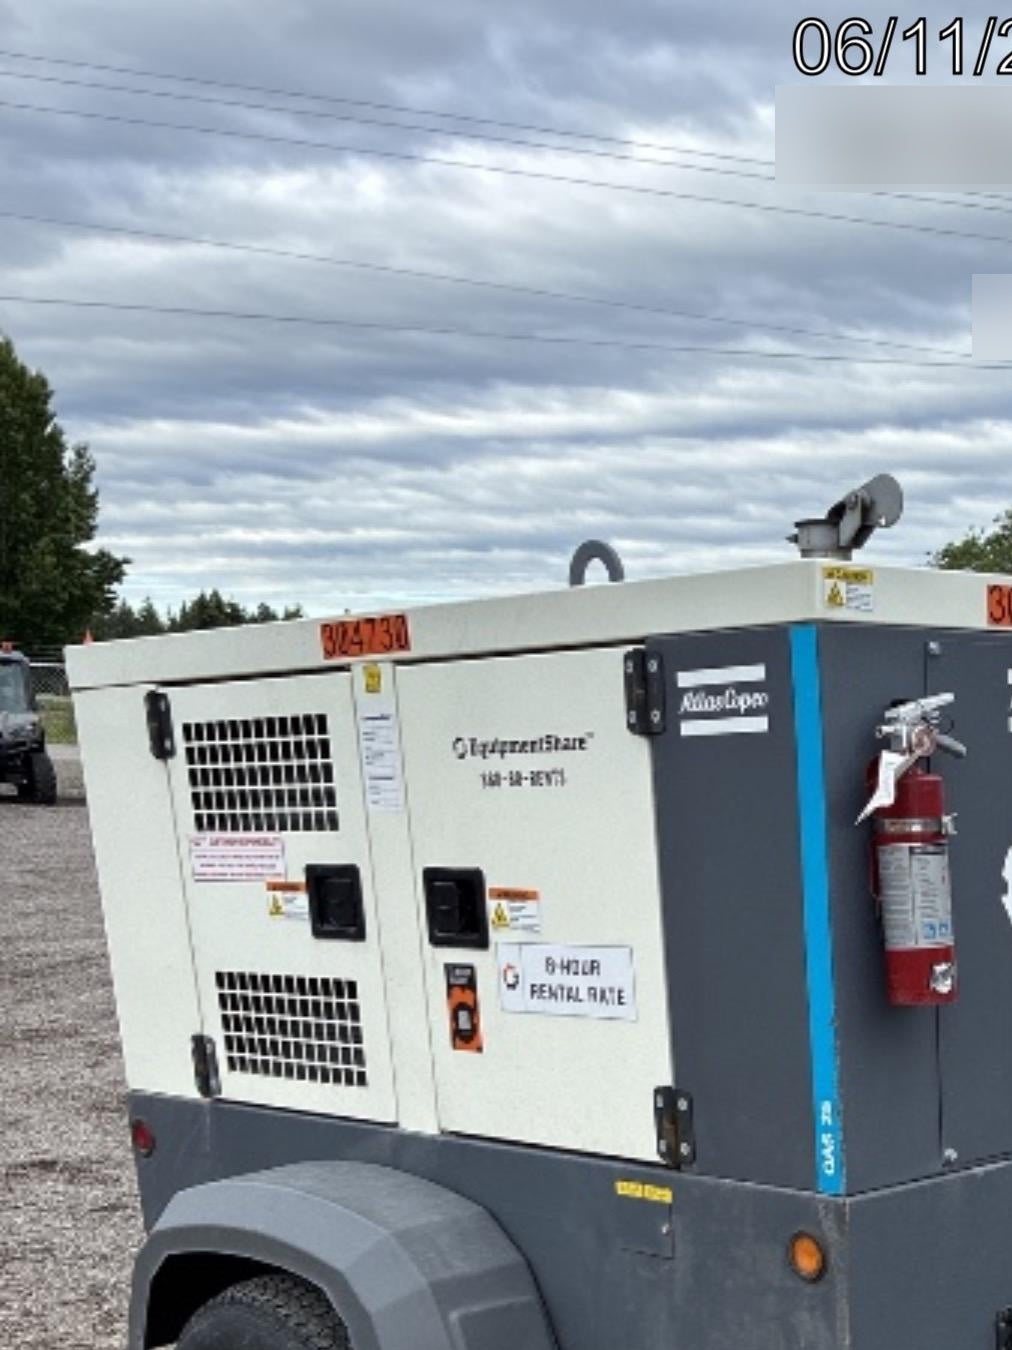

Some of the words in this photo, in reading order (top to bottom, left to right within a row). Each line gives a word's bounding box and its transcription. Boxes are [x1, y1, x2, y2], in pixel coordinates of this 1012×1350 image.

[321, 615, 410, 658] 304730
[529, 983, 583, 1003] RENTAL
[587, 986, 627, 1006] RATE
